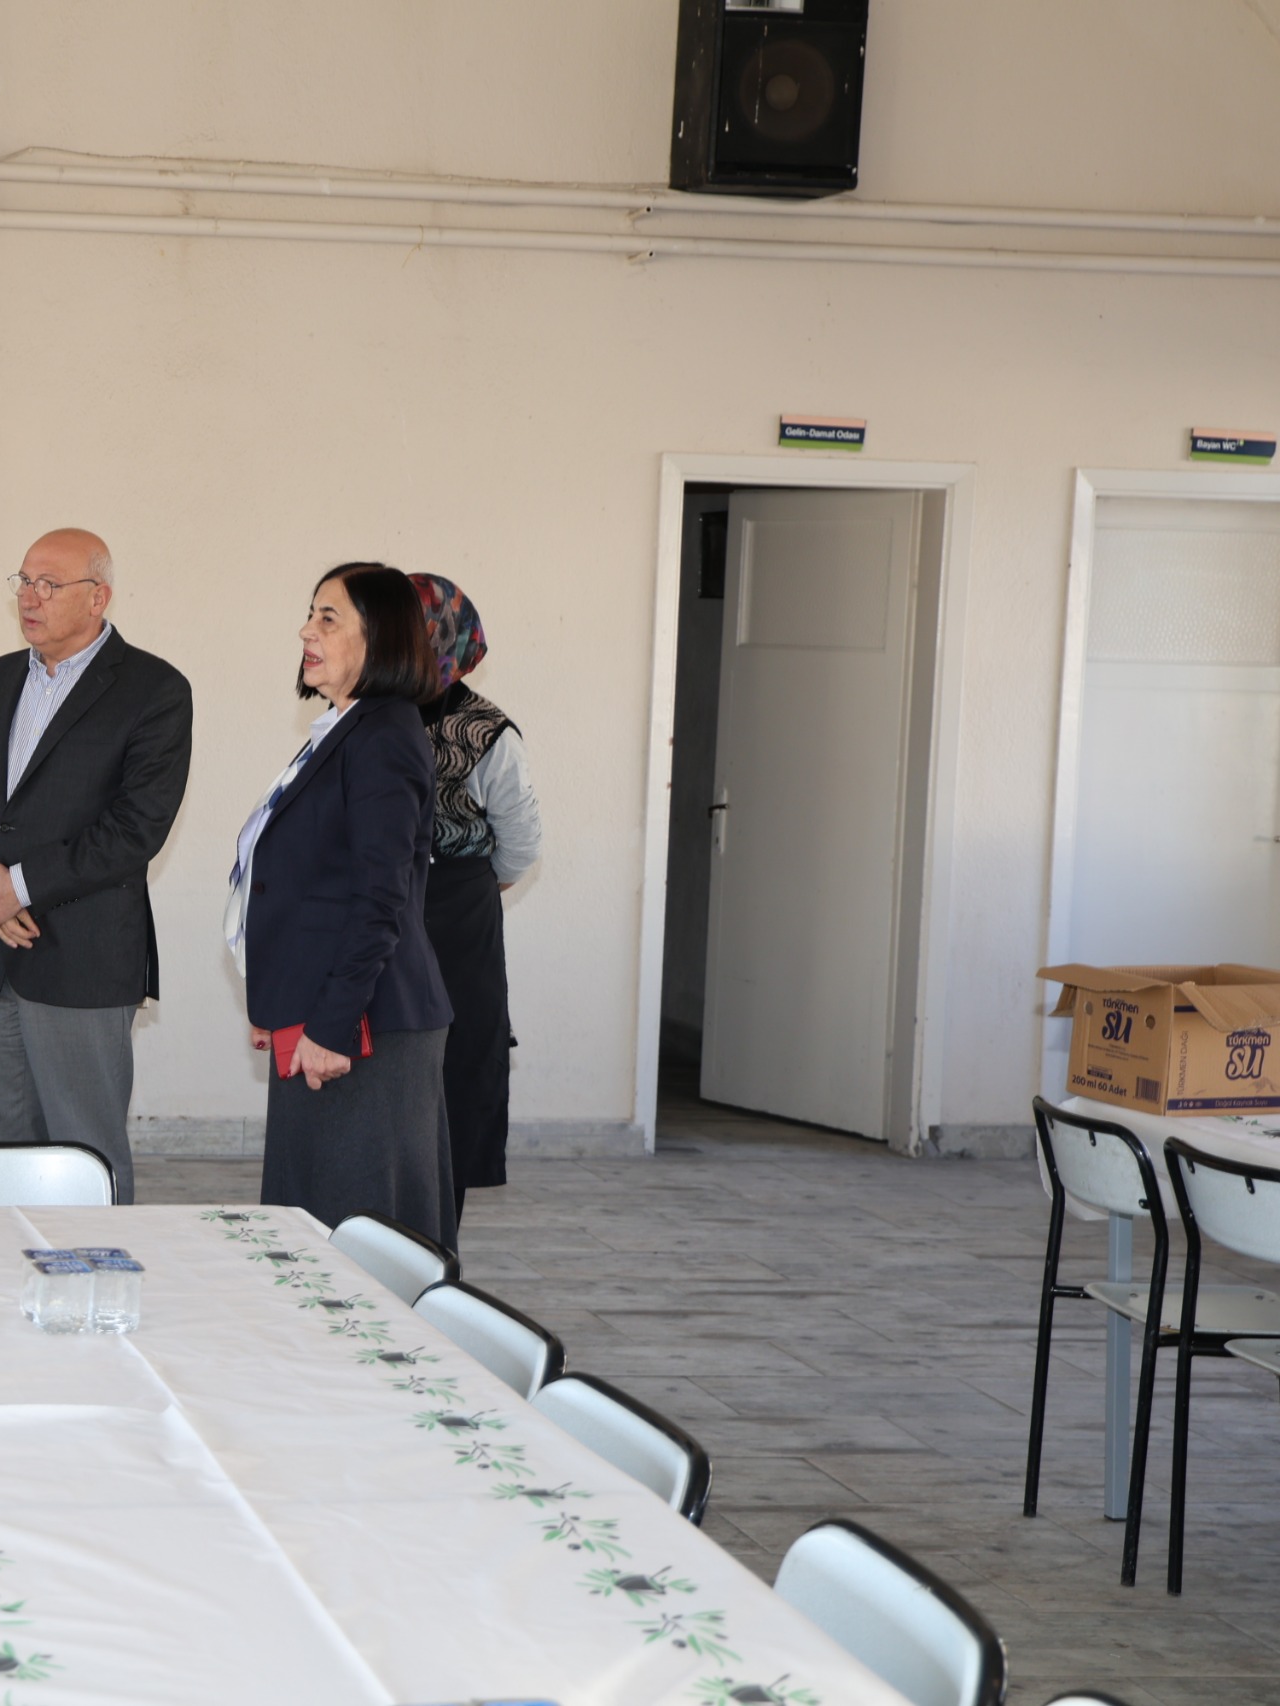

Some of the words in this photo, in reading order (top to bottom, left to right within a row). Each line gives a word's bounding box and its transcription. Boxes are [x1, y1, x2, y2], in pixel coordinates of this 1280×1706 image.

[785, 426, 836, 438] Gelin-Damat
[836, 429, 860, 440] Odası
[1197, 439, 1221, 451] Bayan
[1222, 440, 1237, 451] WC
[1102, 997, 1140, 1015] Türkmen
[1180, 1030, 1189, 1055] DAĞI
[1228, 1034, 1270, 1046] Türkmen
[1176, 1056, 1188, 1096] TÜRKMEN
[1072, 1074, 1086, 1086] 200
[1086, 1079, 1097, 1089] ml
[1098, 1081, 1108, 1092] 60
[1108, 1084, 1128, 1097] Adet
